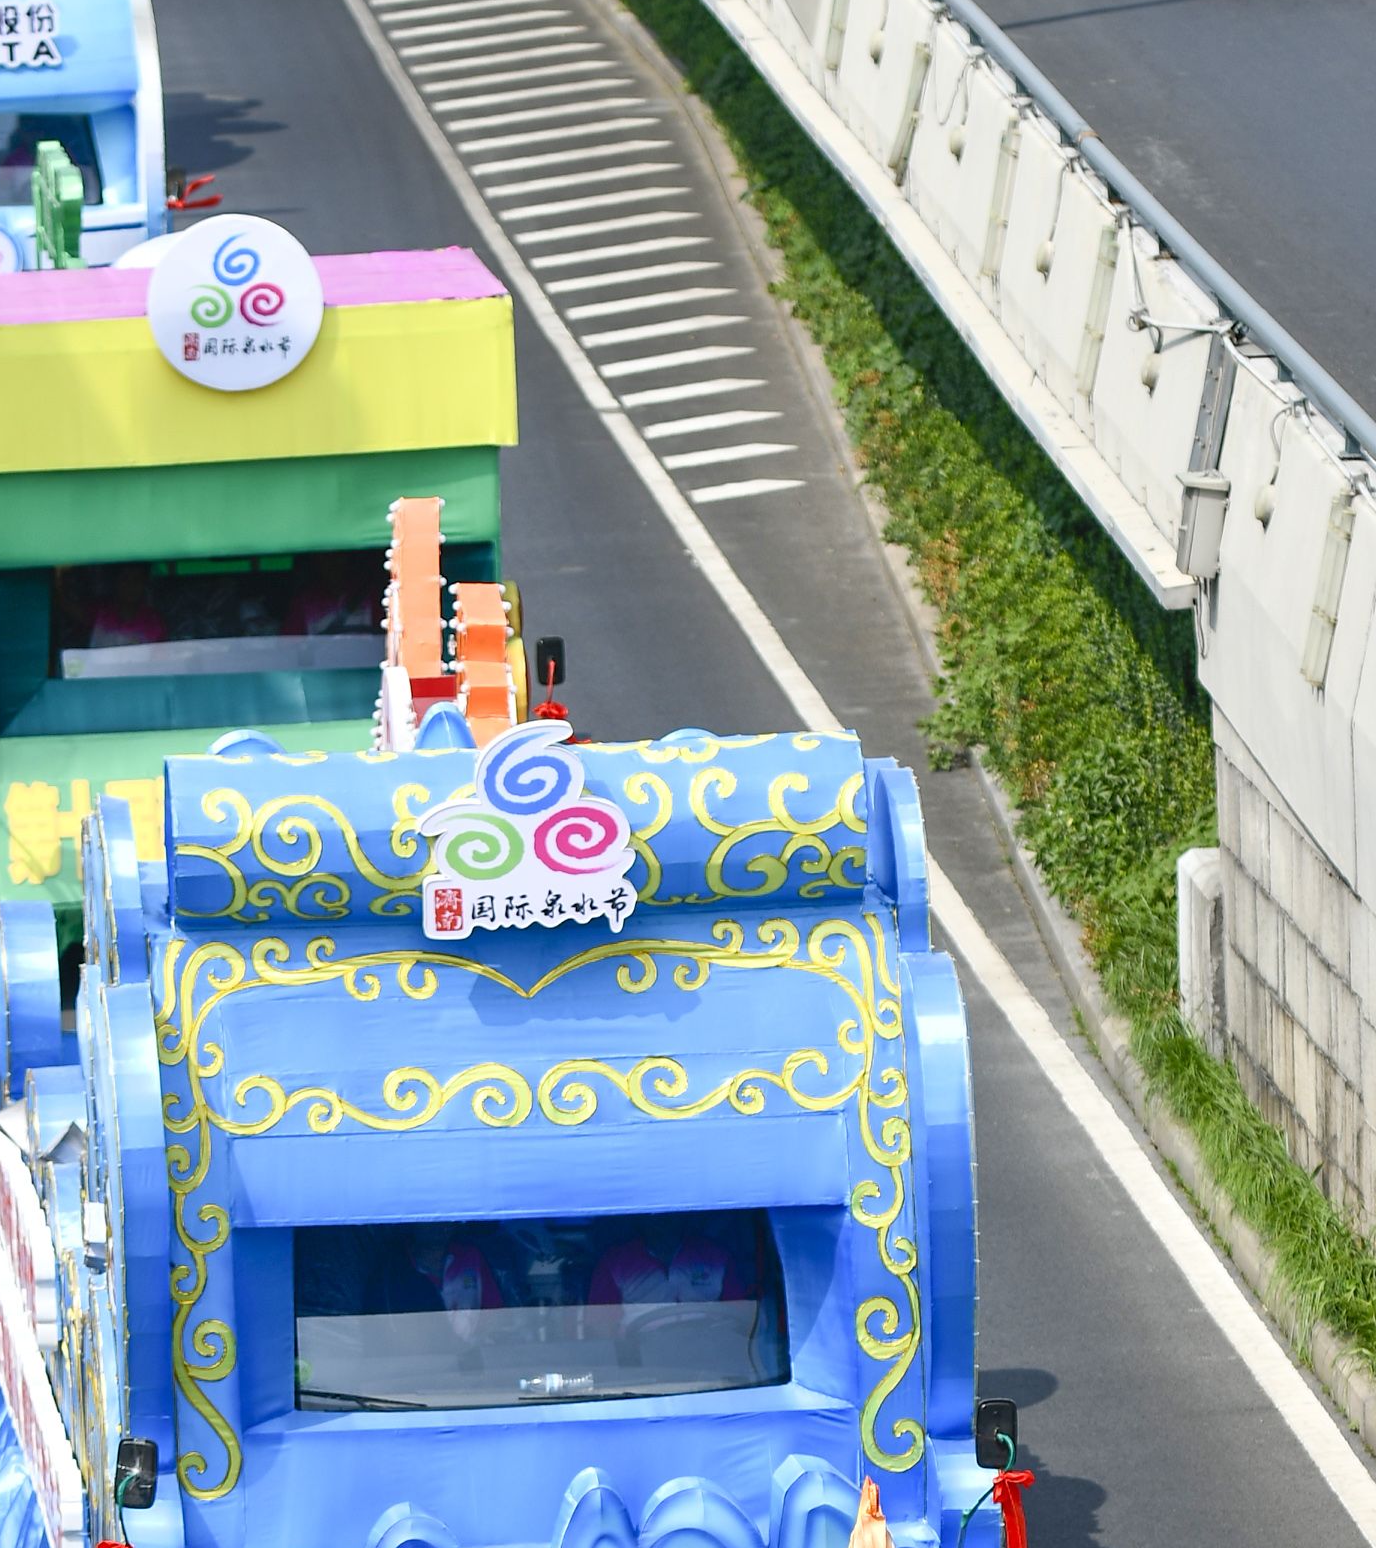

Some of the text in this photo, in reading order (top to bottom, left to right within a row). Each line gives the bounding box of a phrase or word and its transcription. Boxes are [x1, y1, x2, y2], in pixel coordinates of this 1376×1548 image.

[471, 887, 630, 923] 国际泉水节
